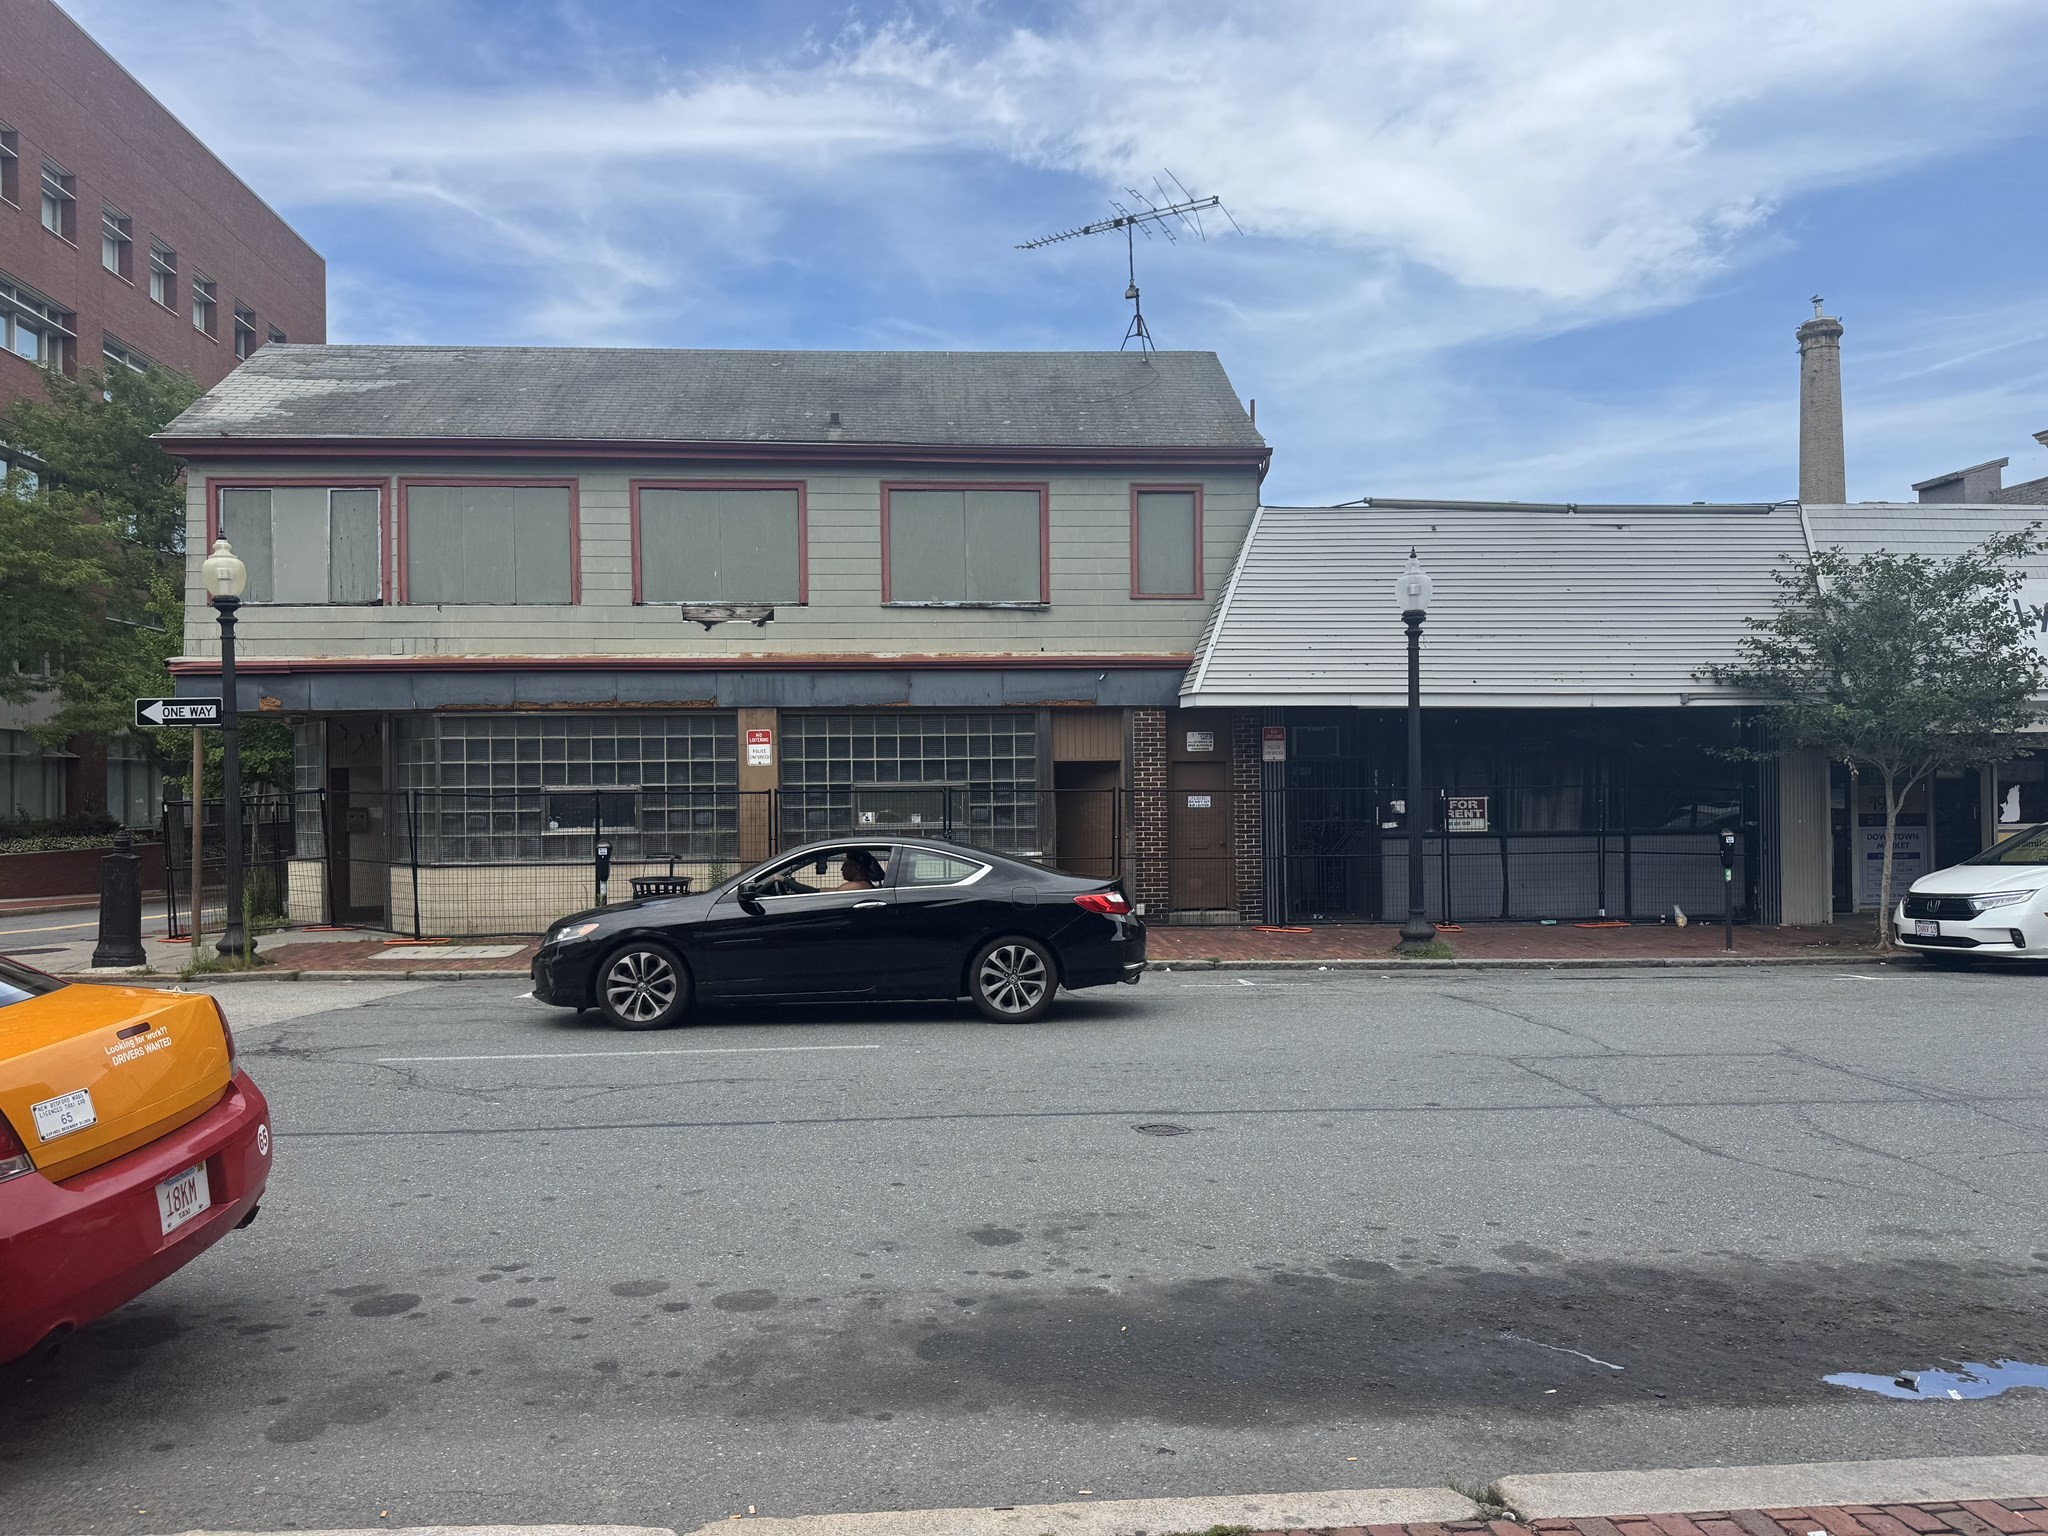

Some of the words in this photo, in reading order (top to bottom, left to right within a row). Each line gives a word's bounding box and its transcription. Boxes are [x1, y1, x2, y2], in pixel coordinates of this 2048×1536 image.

[163, 706, 185, 717] ONE
[190, 706, 213, 717] WAY
[1449, 800, 1478, 809] FOR
[1448, 809, 1484, 818] RENT
[1866, 832, 1919, 841] DOWTOWN
[1876, 841, 1910, 850] MKET
[104, 1039, 136, 1055] Looking
[135, 1035, 145, 1044] for
[145, 1026, 168, 1040] work??
[112, 1047, 145, 1066] DRIVERS
[144, 1037, 172, 1053] WANTED
[50, 1097, 71, 1108] BEDFORD
[72, 1093, 84, 1101] MASS
[64, 1102, 76, 1110] TAXI
[60, 1111, 74, 1125] 65
[61, 1122, 79, 1132] DECEMBER
[258, 1128, 268, 1151] 65
[166, 1176, 198, 1217] 18KM
